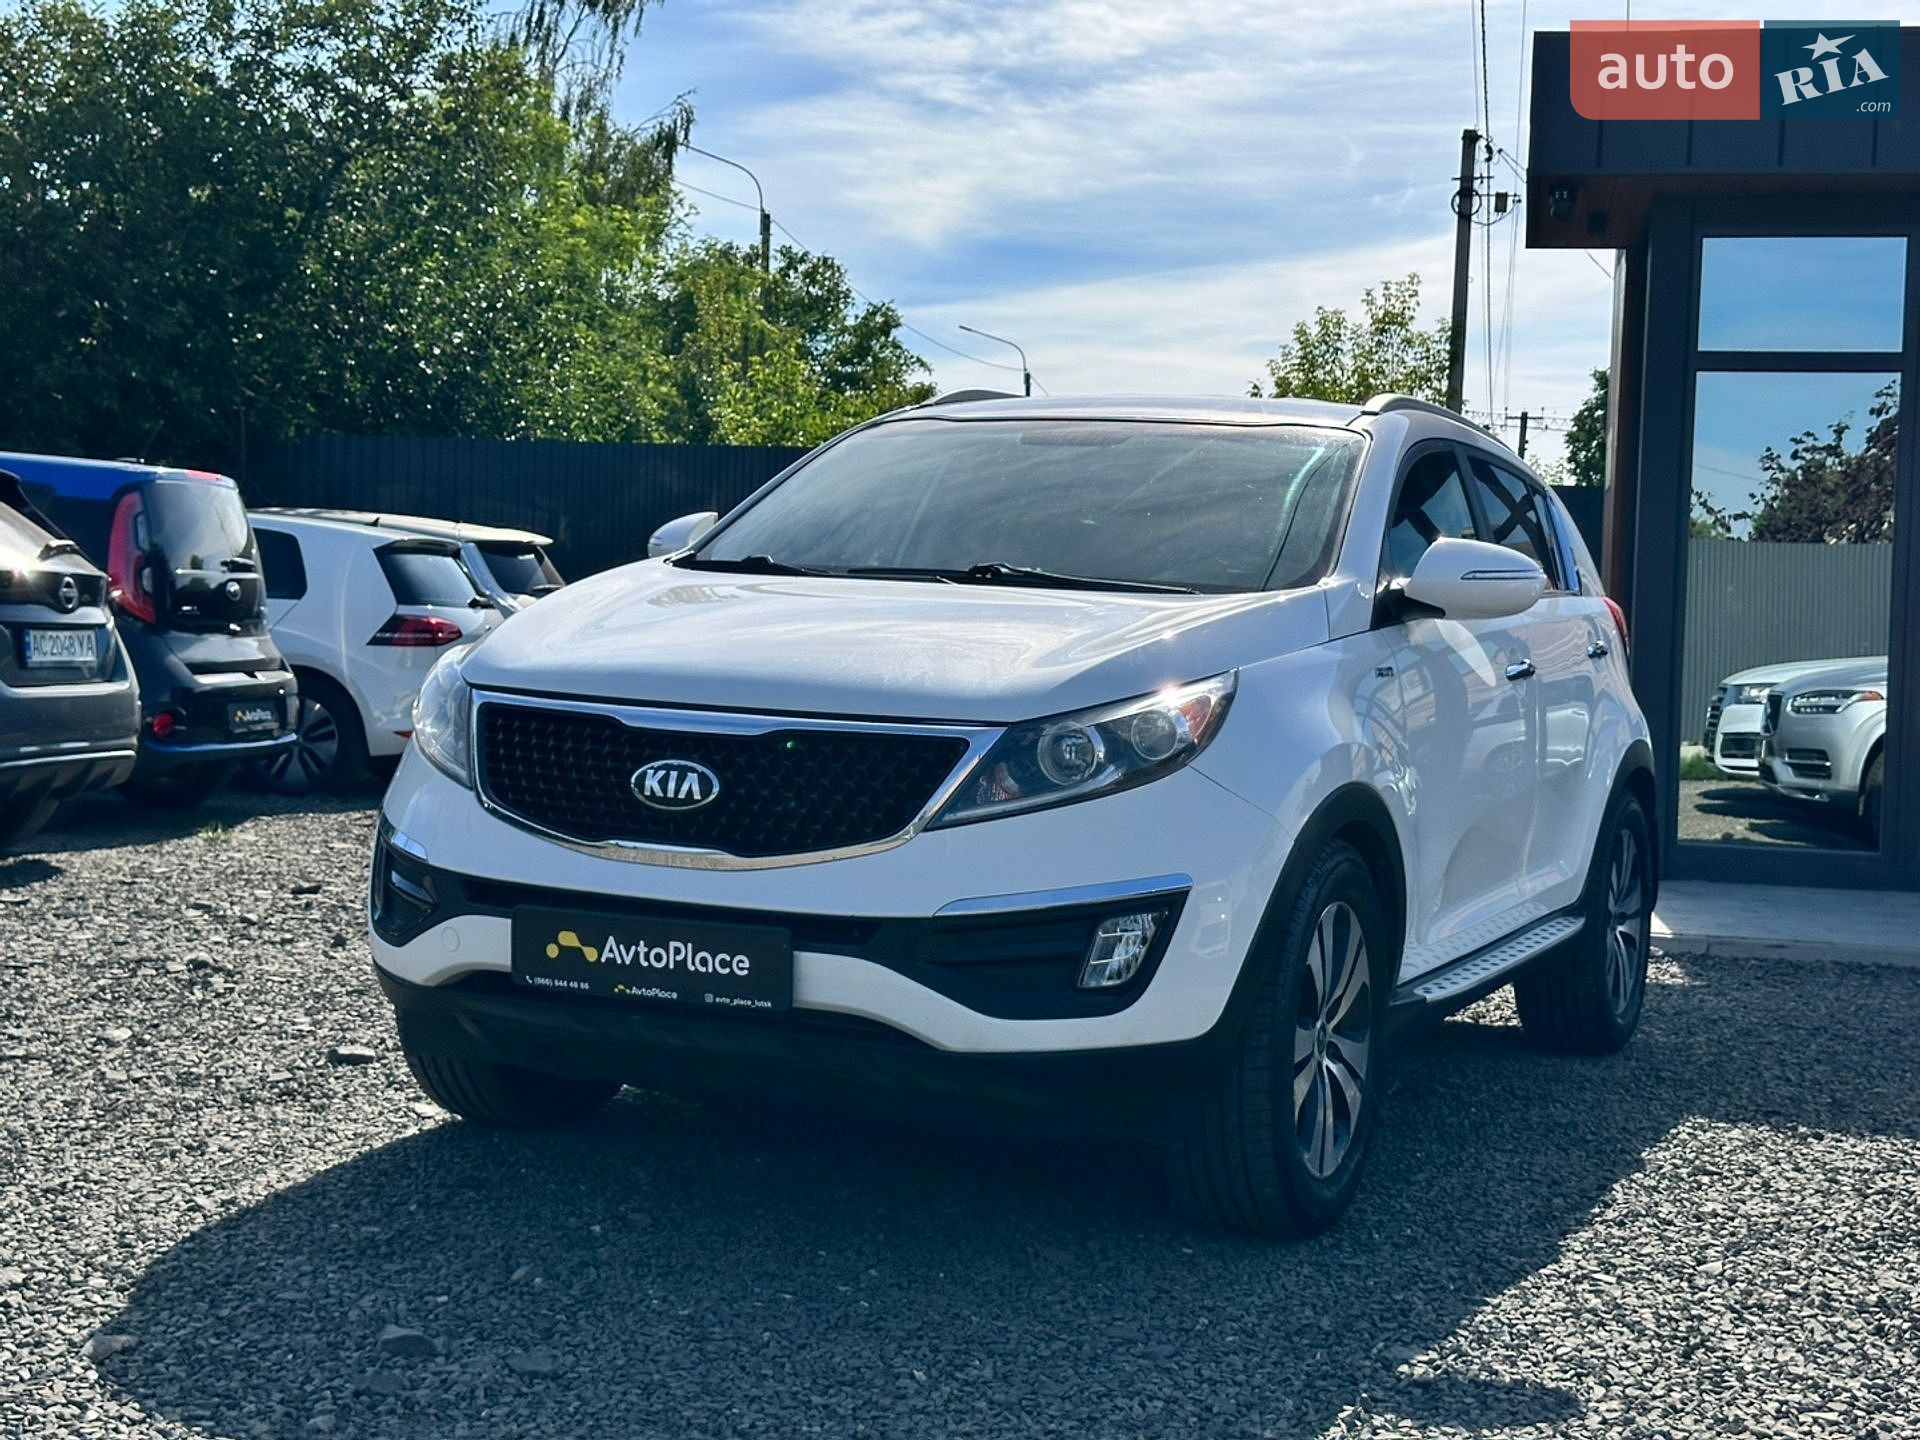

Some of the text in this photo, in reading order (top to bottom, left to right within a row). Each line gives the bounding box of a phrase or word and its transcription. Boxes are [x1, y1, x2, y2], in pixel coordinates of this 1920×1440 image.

[644, 769, 702, 800] KIA
[601, 935, 750, 976] AvtoPlace
[631, 985, 678, 1000] AvtoPlace
